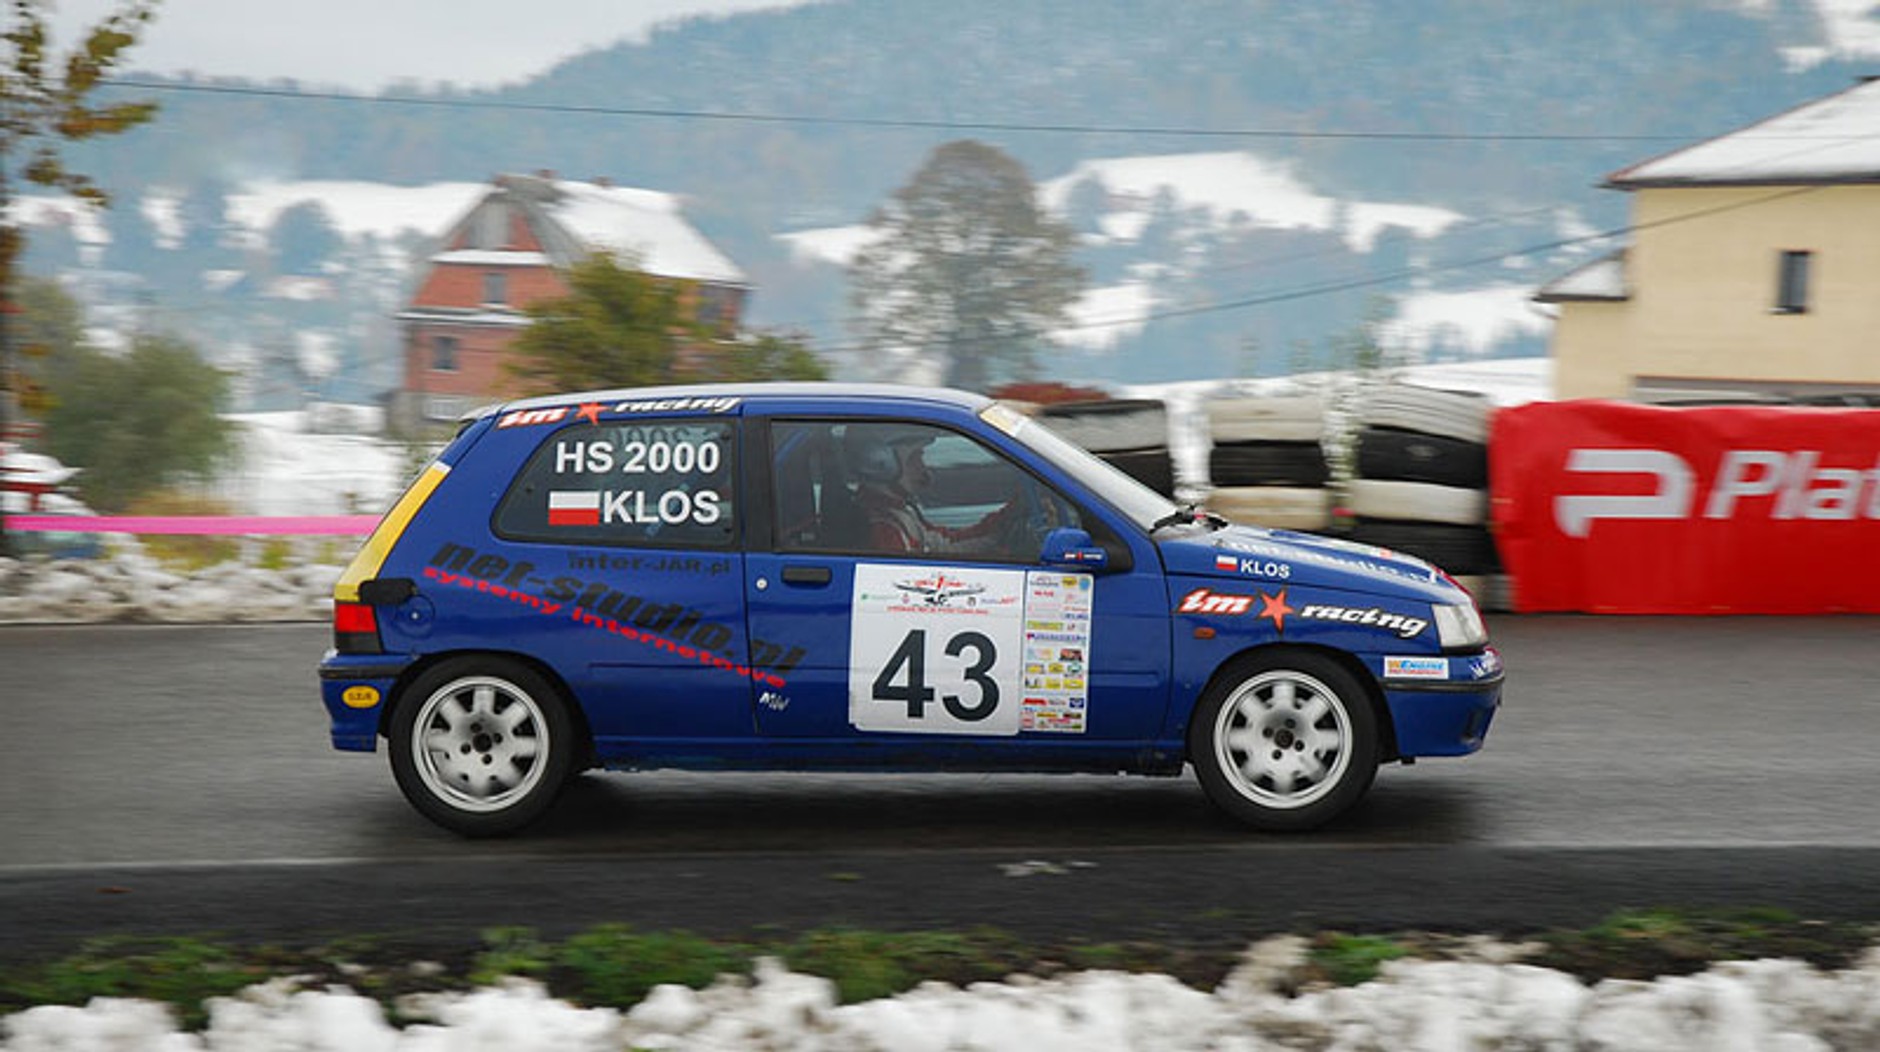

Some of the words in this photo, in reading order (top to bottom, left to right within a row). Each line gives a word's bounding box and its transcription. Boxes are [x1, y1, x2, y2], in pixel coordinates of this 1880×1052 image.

[615, 397, 740, 413] racing
[555, 441, 614, 474] HS
[622, 441, 721, 474] 2000
[603, 490, 720, 524] KLOS
[1241, 559, 1291, 578] KLOS
[429, 542, 808, 673] net-studio.pl
[1300, 604, 1428, 638] racing
[422, 566, 562, 615] systemy
[571, 607, 786, 688] internetowe
[872, 629, 1000, 722] 43
